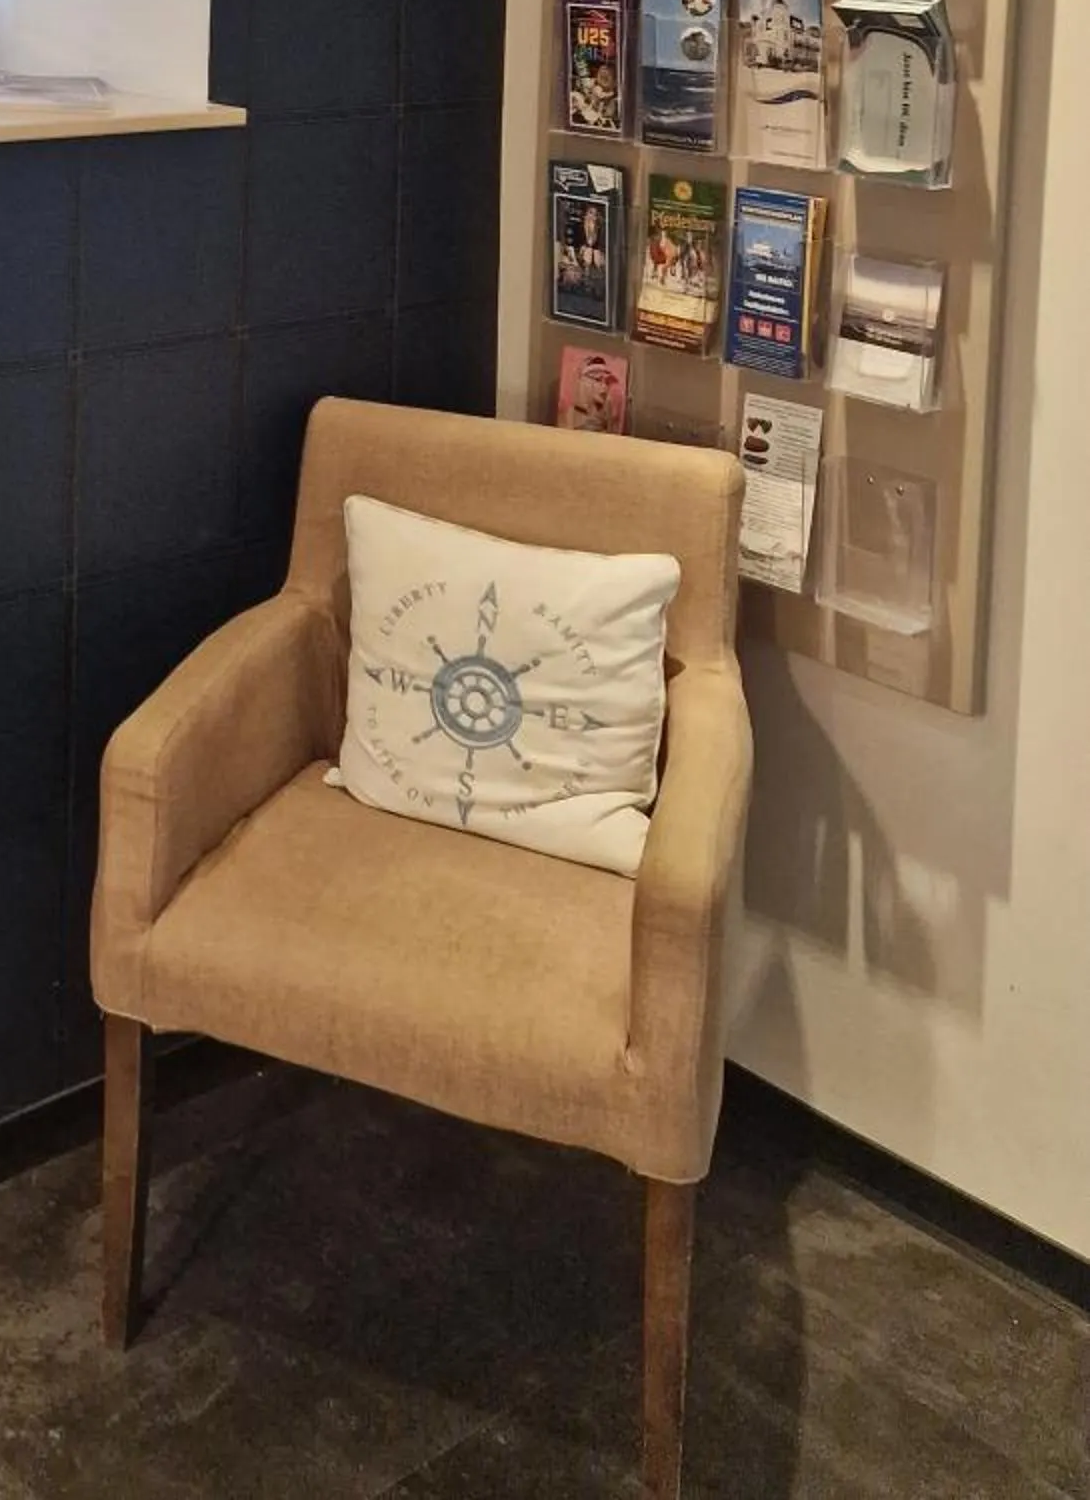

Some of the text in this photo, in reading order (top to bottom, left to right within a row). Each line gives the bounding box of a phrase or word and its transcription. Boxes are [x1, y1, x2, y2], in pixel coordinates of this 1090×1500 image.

[577, 26, 612, 47] U25
[379, 581, 447, 636] LIBERTY
[390, 667, 413, 695] W
[547, 703, 569, 732] E
[458, 771, 476, 798] S
